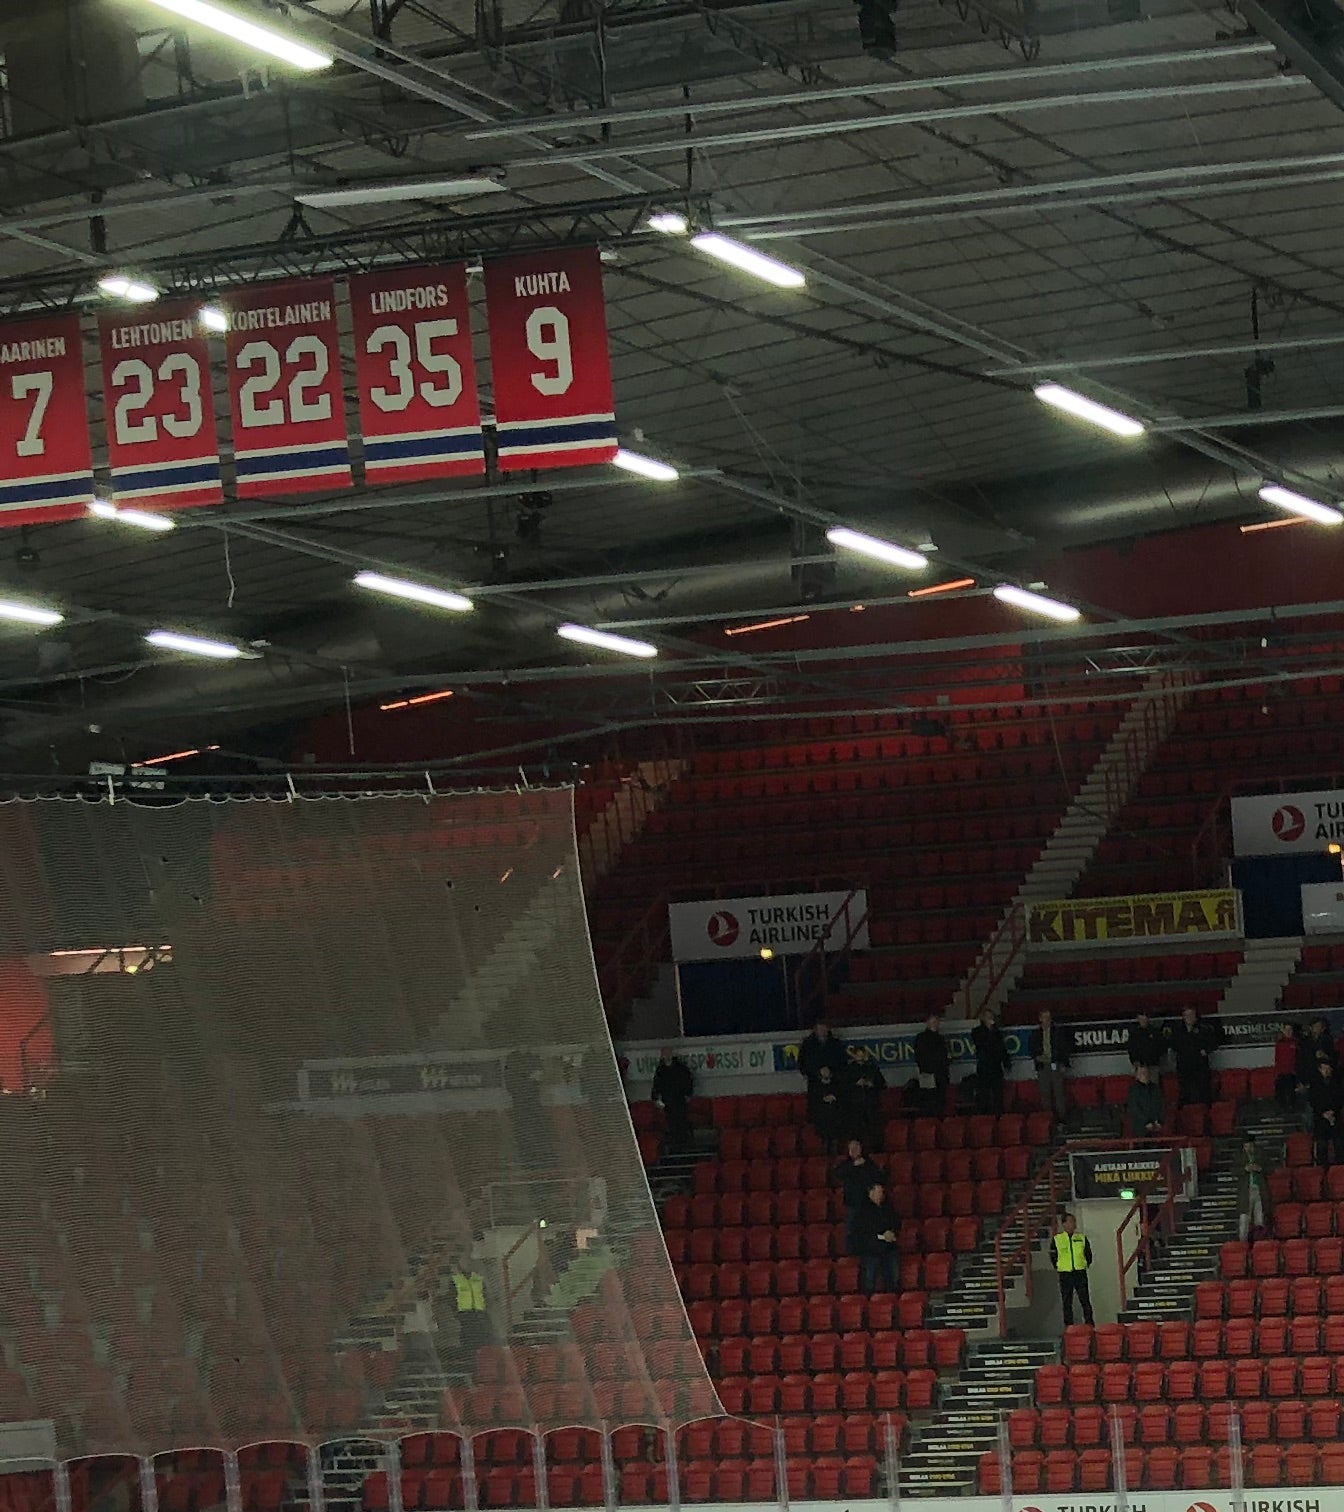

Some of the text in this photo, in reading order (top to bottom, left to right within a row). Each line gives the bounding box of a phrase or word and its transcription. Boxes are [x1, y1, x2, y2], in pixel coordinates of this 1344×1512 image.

[370, 284, 449, 315] LINDFORS
[514, 271, 571, 298] KUHTA
[227, 300, 331, 333] KORTELAINEN
[111, 319, 195, 350] LEHTONEN
[366, 318, 463, 413] 35
[525, 306, 574, 397] 9
[236, 334, 332, 428] 22
[12, 371, 53, 457] 7
[111, 352, 203, 445] 23
[748, 904, 829, 925] TURKISH
[750, 924, 832, 945] AIRLINES
